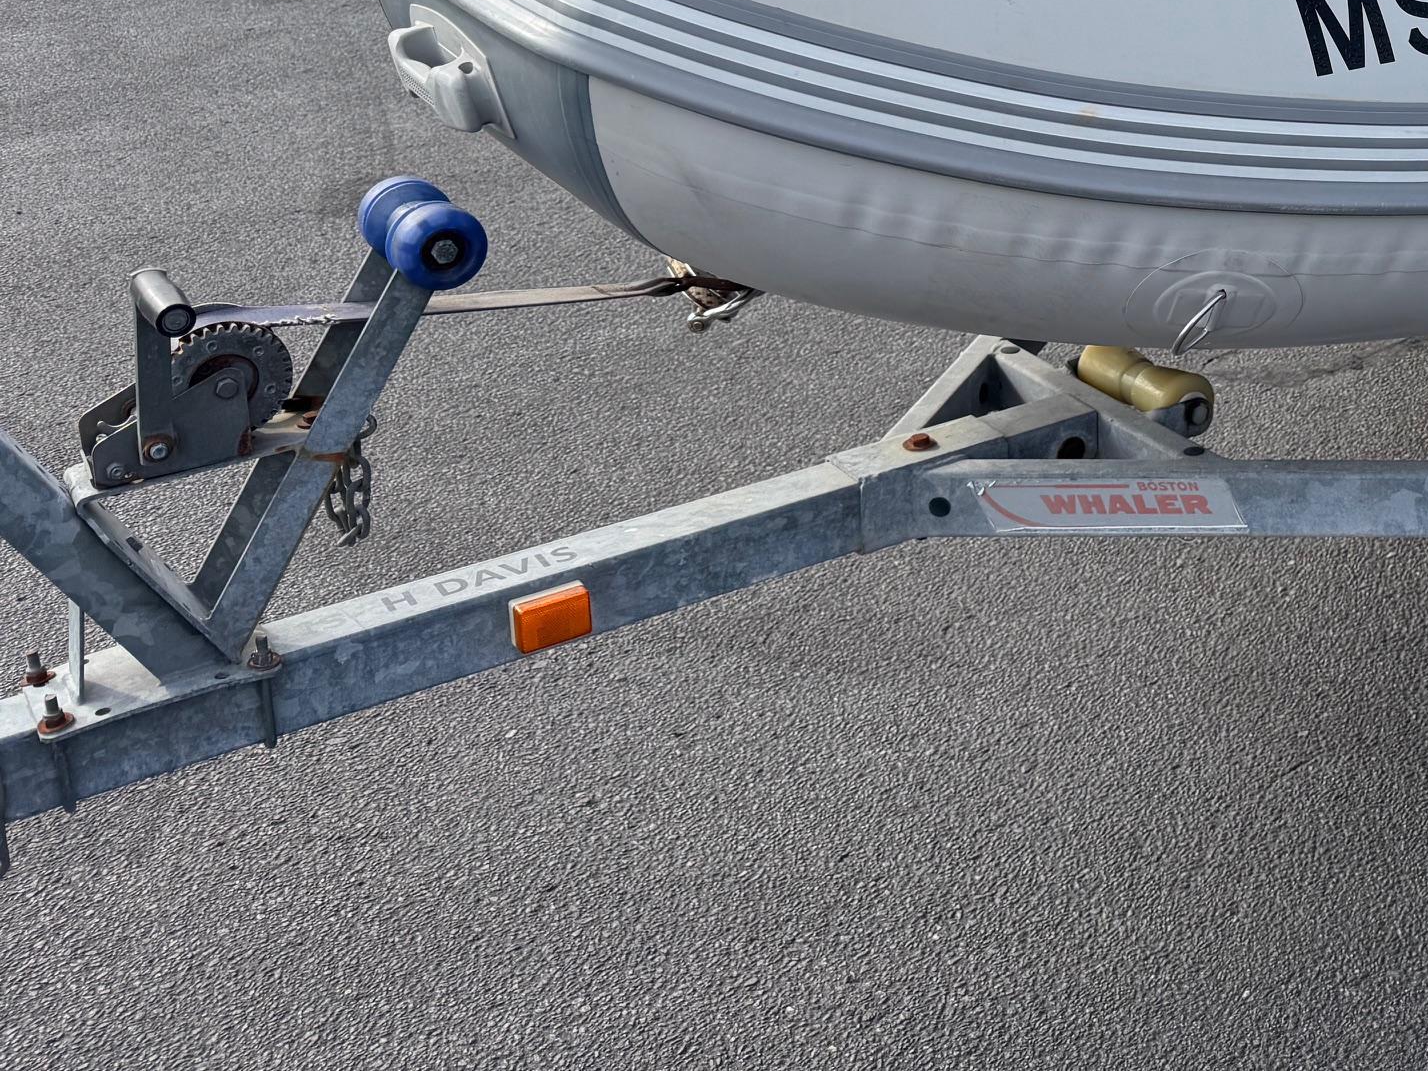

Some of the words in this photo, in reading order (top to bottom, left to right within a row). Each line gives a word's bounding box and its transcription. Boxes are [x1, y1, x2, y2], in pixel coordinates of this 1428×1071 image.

[1137, 482, 1199, 492] BOSTON
[1040, 494, 1213, 514] WHALER
[381, 591, 417, 612] H
[433, 547, 577, 597] DAVIS
